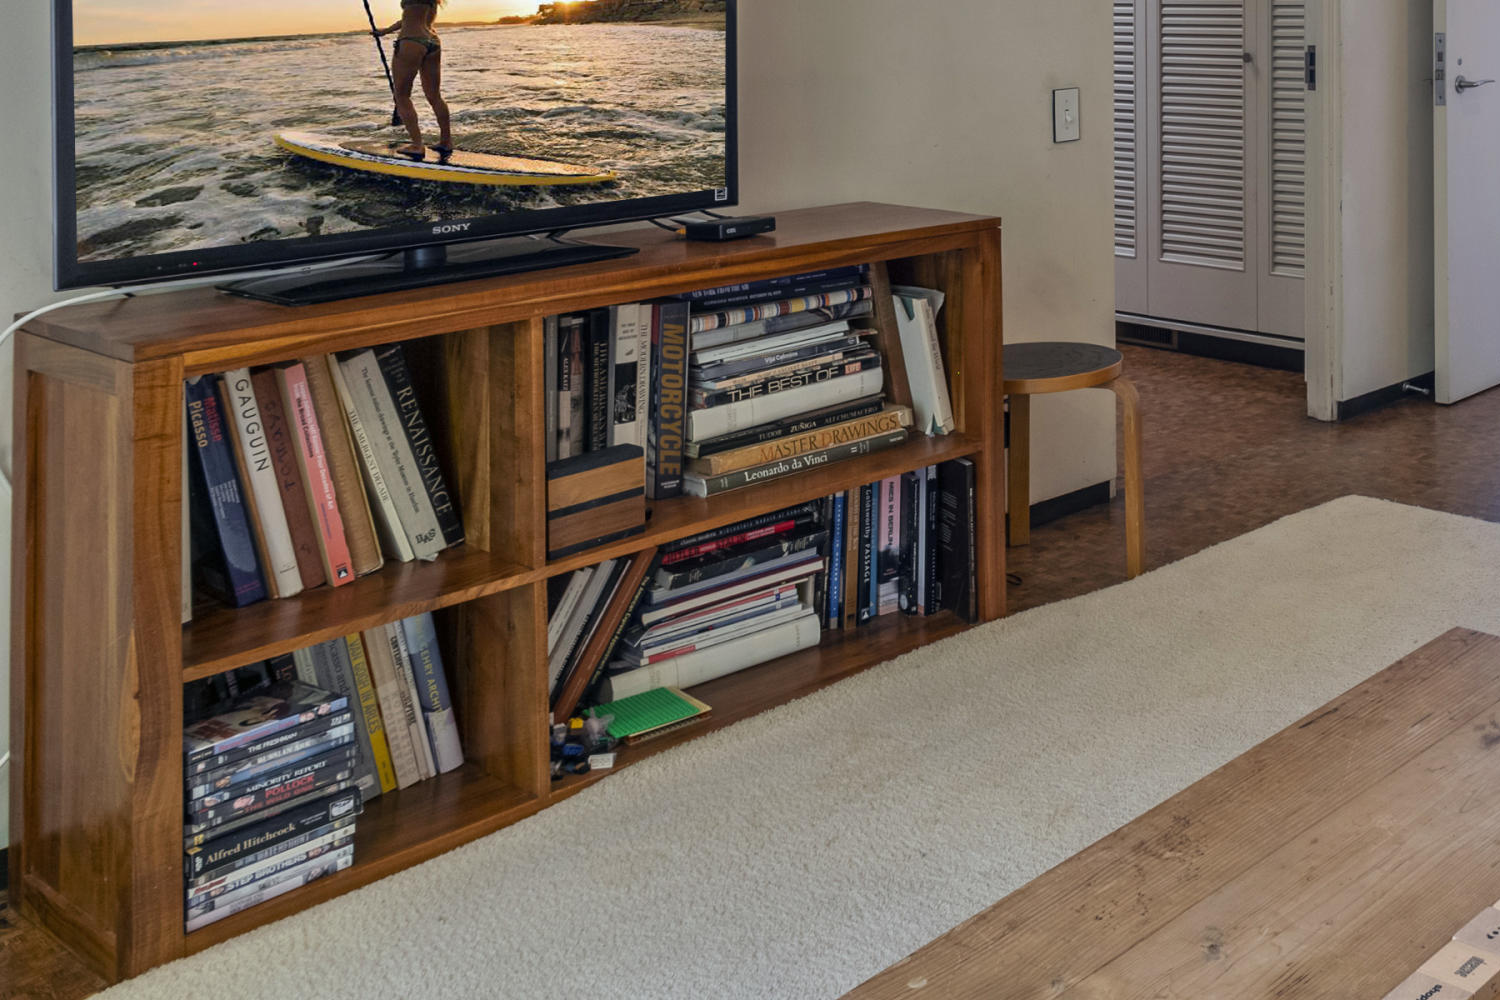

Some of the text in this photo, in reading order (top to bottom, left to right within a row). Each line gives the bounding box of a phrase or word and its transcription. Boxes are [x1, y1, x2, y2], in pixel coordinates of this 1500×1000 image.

[432, 223, 471, 234] SONY
[661, 323, 684, 475] MOTORCYCLE
[727, 384, 764, 402] THE
[766, 373, 812, 393] BEST
[814, 367, 840, 382] OF
[188, 400, 208, 448] Picasso
[235, 378, 271, 473] GAUGUIN
[759, 416, 898, 462] MASTER DRAWINGS
[397, 386, 453, 516] RENAISSANCE
[744, 452, 828, 483] Leonardo da Vinci
[862, 489, 872, 583] Goldsworthy PASSAGE
[246, 760, 328, 793] MINORITY REPORT
[264, 773, 315, 798] POLLOCK
[206, 823, 297, 866] Alfred Hitchcock
[224, 873, 255, 891] STEP
